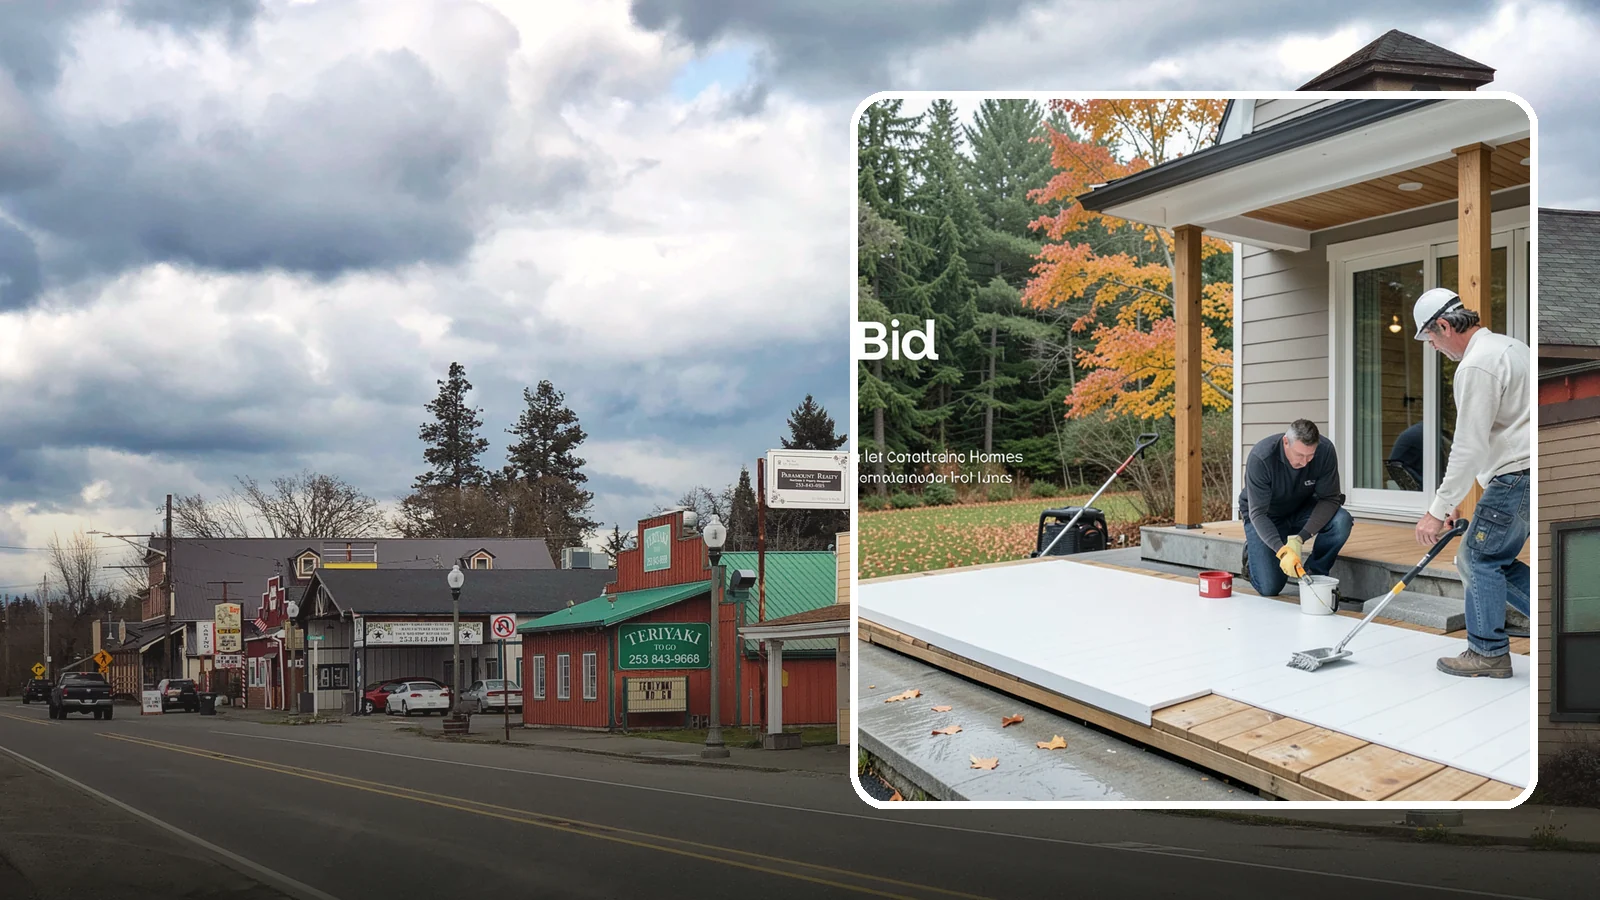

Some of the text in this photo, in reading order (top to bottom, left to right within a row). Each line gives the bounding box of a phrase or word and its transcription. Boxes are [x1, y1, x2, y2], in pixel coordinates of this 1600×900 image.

[781, 471, 839, 480] PARAMOUNT REALTY
[624, 627, 702, 646] TERIYAKI
[653, 643, 677, 651] TO GO
[628, 653, 700, 665] 253 843-9668
